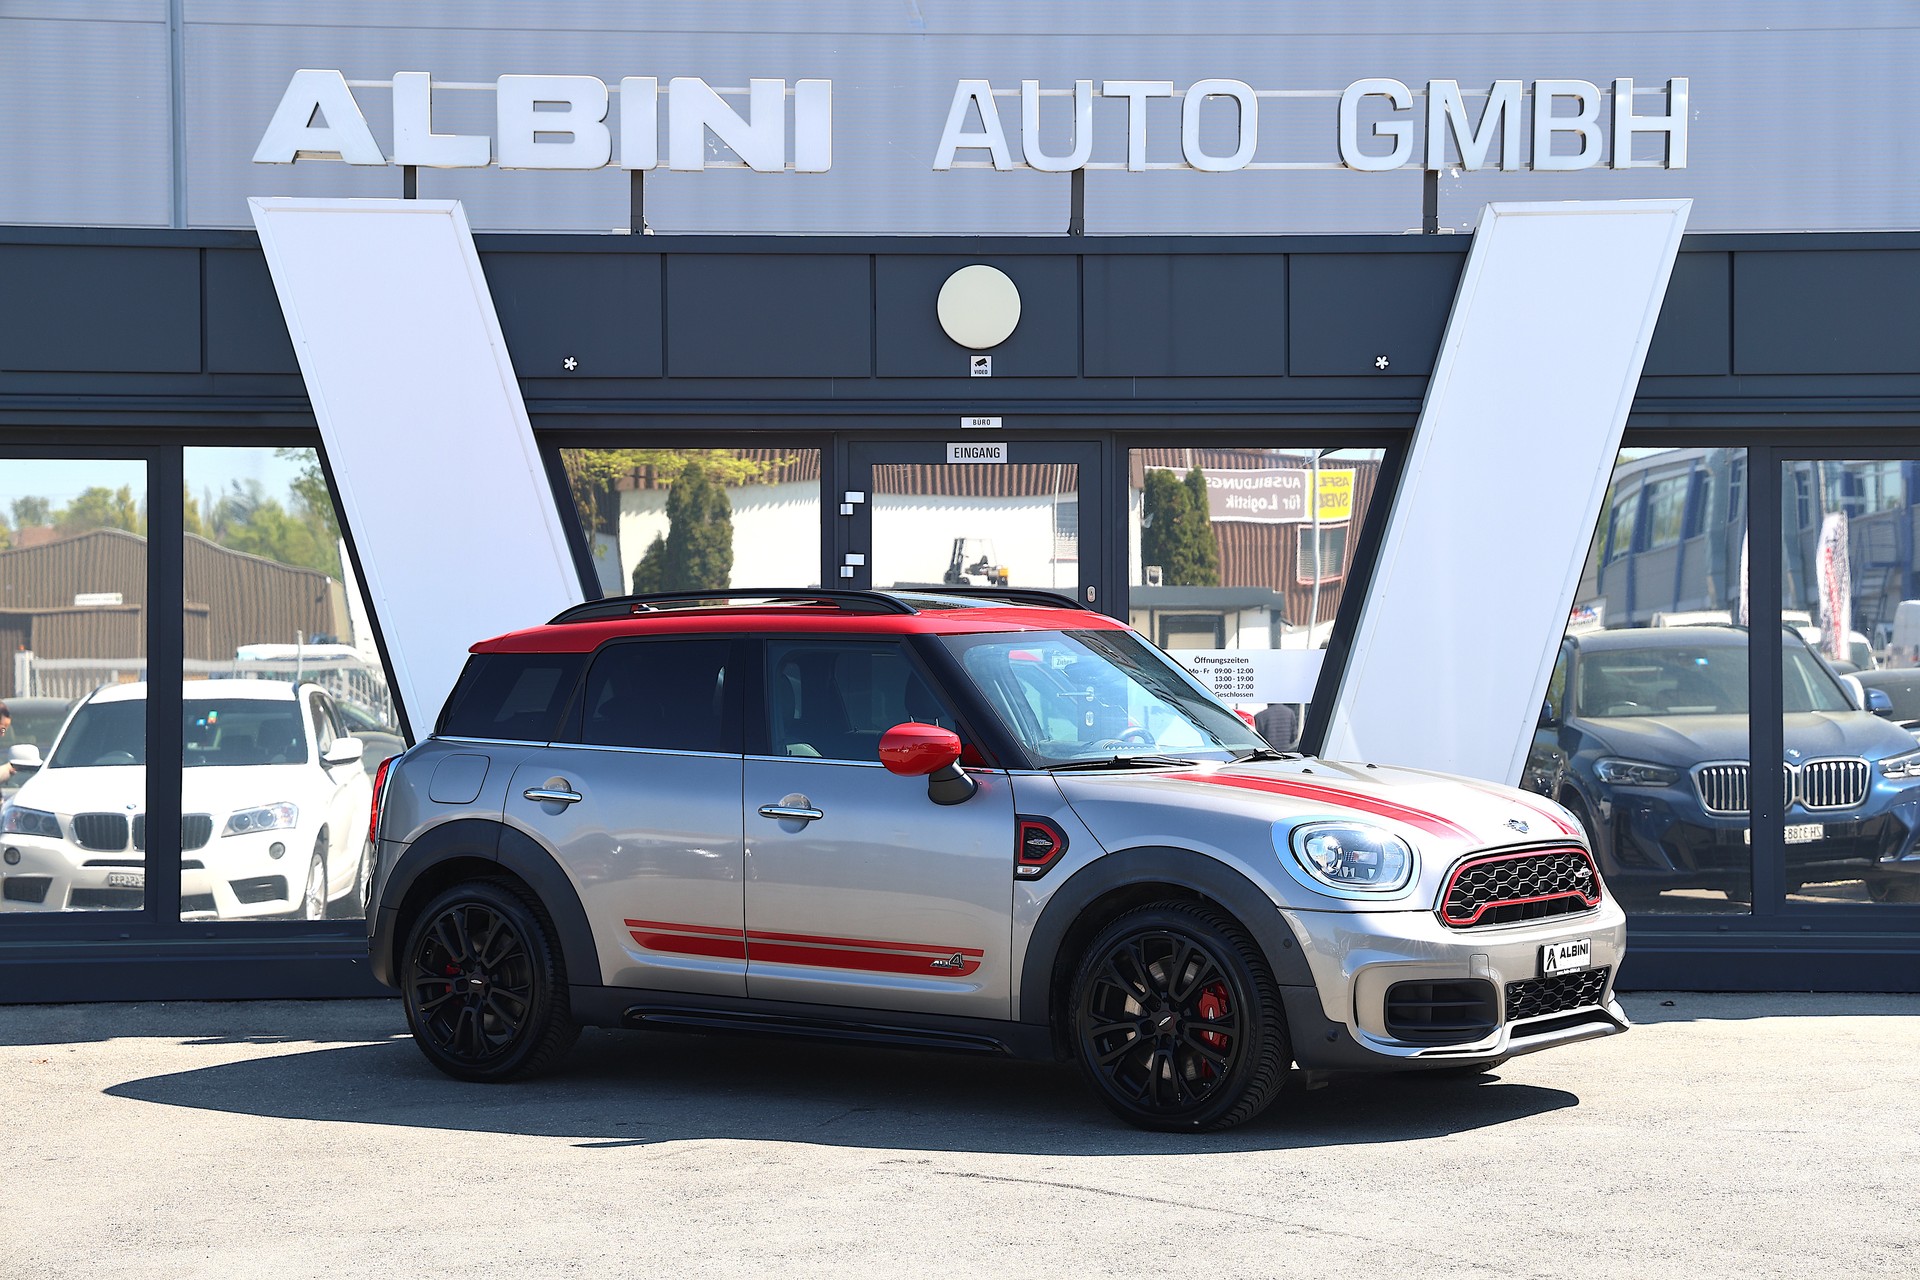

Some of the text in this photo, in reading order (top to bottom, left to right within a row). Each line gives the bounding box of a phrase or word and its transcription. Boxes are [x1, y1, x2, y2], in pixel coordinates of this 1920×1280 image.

[252, 69, 1689, 173] ALBINI AUTO GMBH
[972, 417, 991, 426] BÜRO
[954, 447, 1000, 459] EINGANG
[1194, 656, 1249, 665] Öffnungszeiten
[1560, 943, 1588, 959] ALBINI
